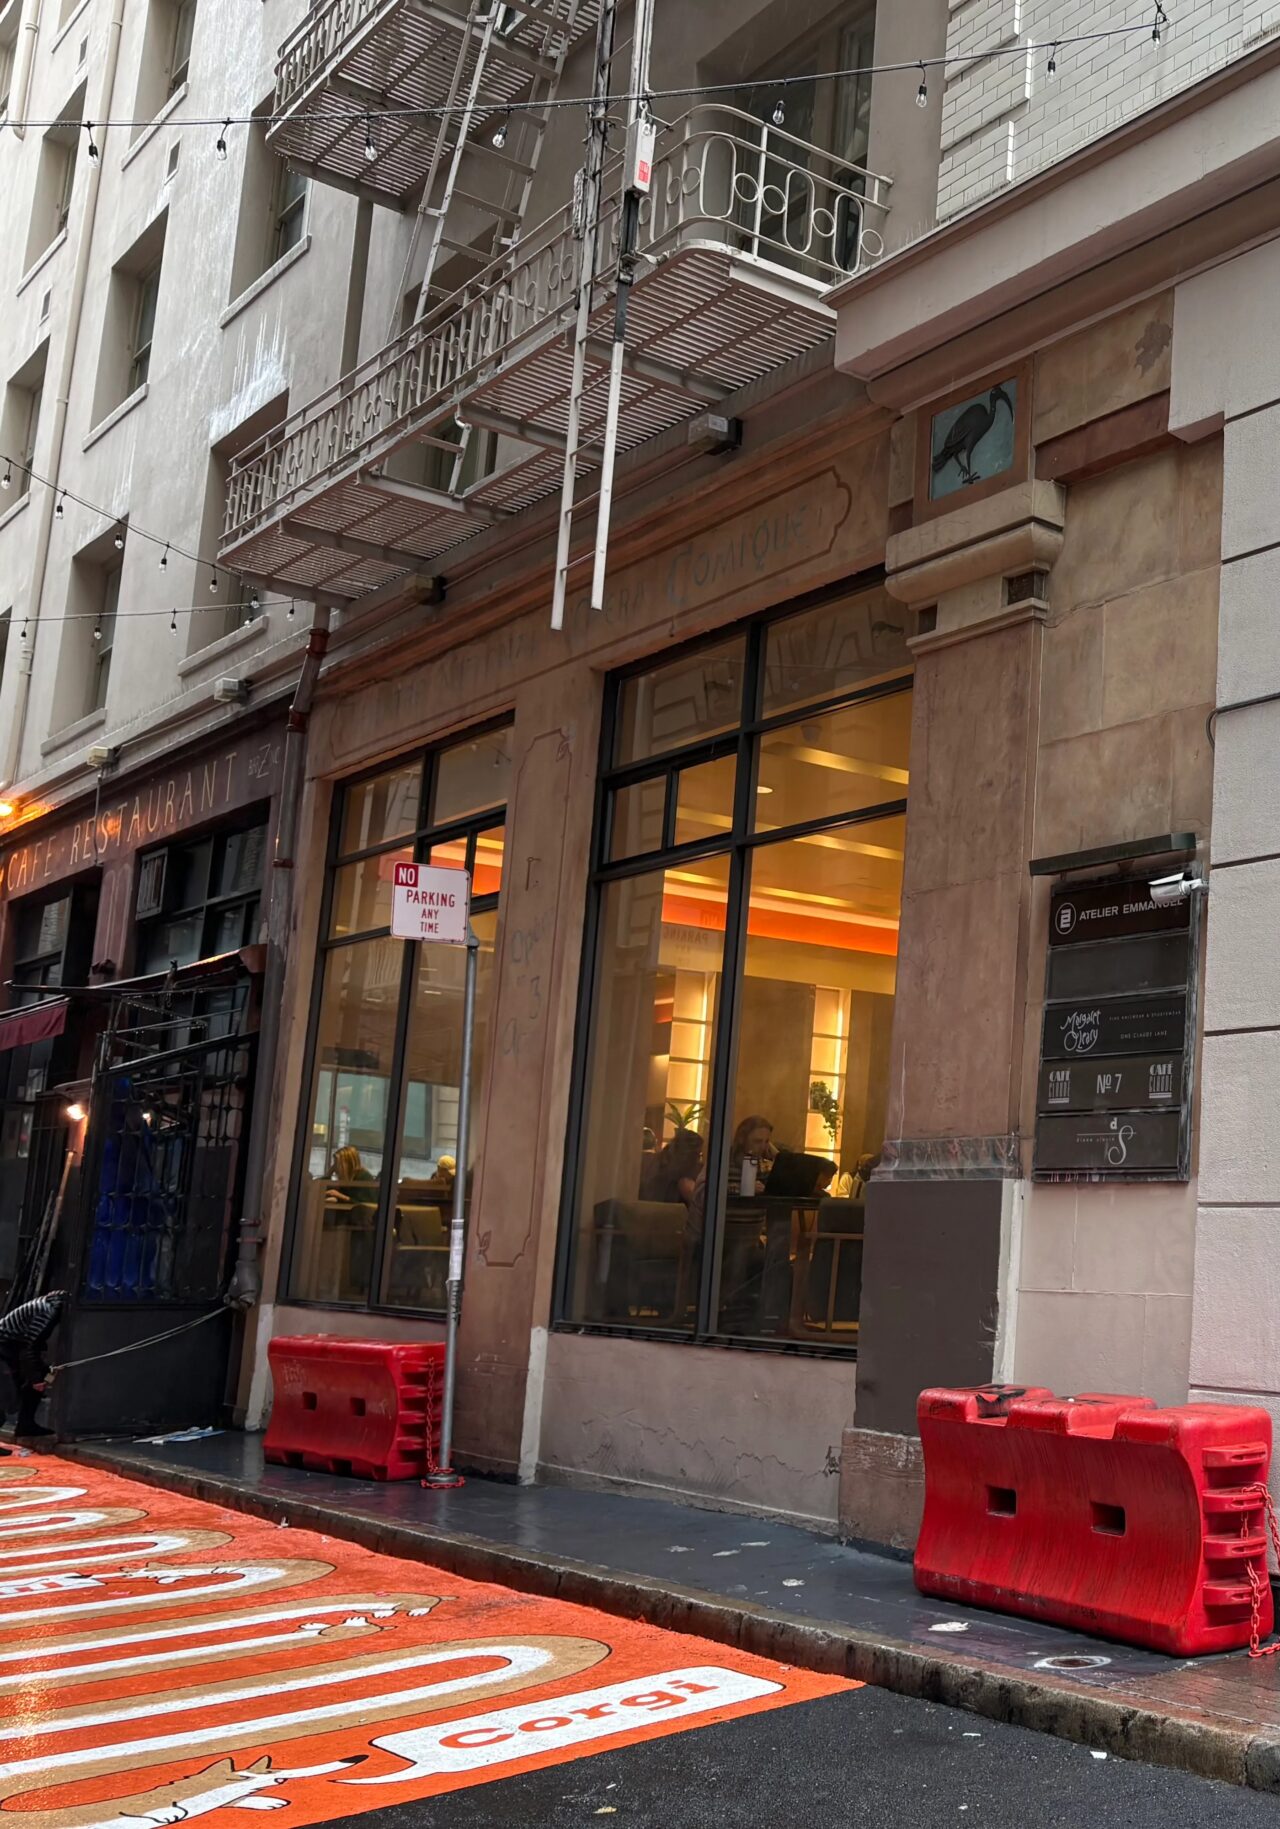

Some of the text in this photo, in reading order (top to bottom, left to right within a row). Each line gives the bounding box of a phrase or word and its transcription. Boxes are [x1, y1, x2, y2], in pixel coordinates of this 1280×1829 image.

[70, 752, 237, 865] RESTAURANT
[398, 867, 415, 885] NO
[406, 889, 455, 908] PARKING
[421, 908, 439, 920] ANY
[1079, 905, 1119, 921] ATELIER
[420, 921, 439, 934] TIME
[1115, 1073, 1122, 1093] 7
[438, 1679, 719, 1749] Corgi
